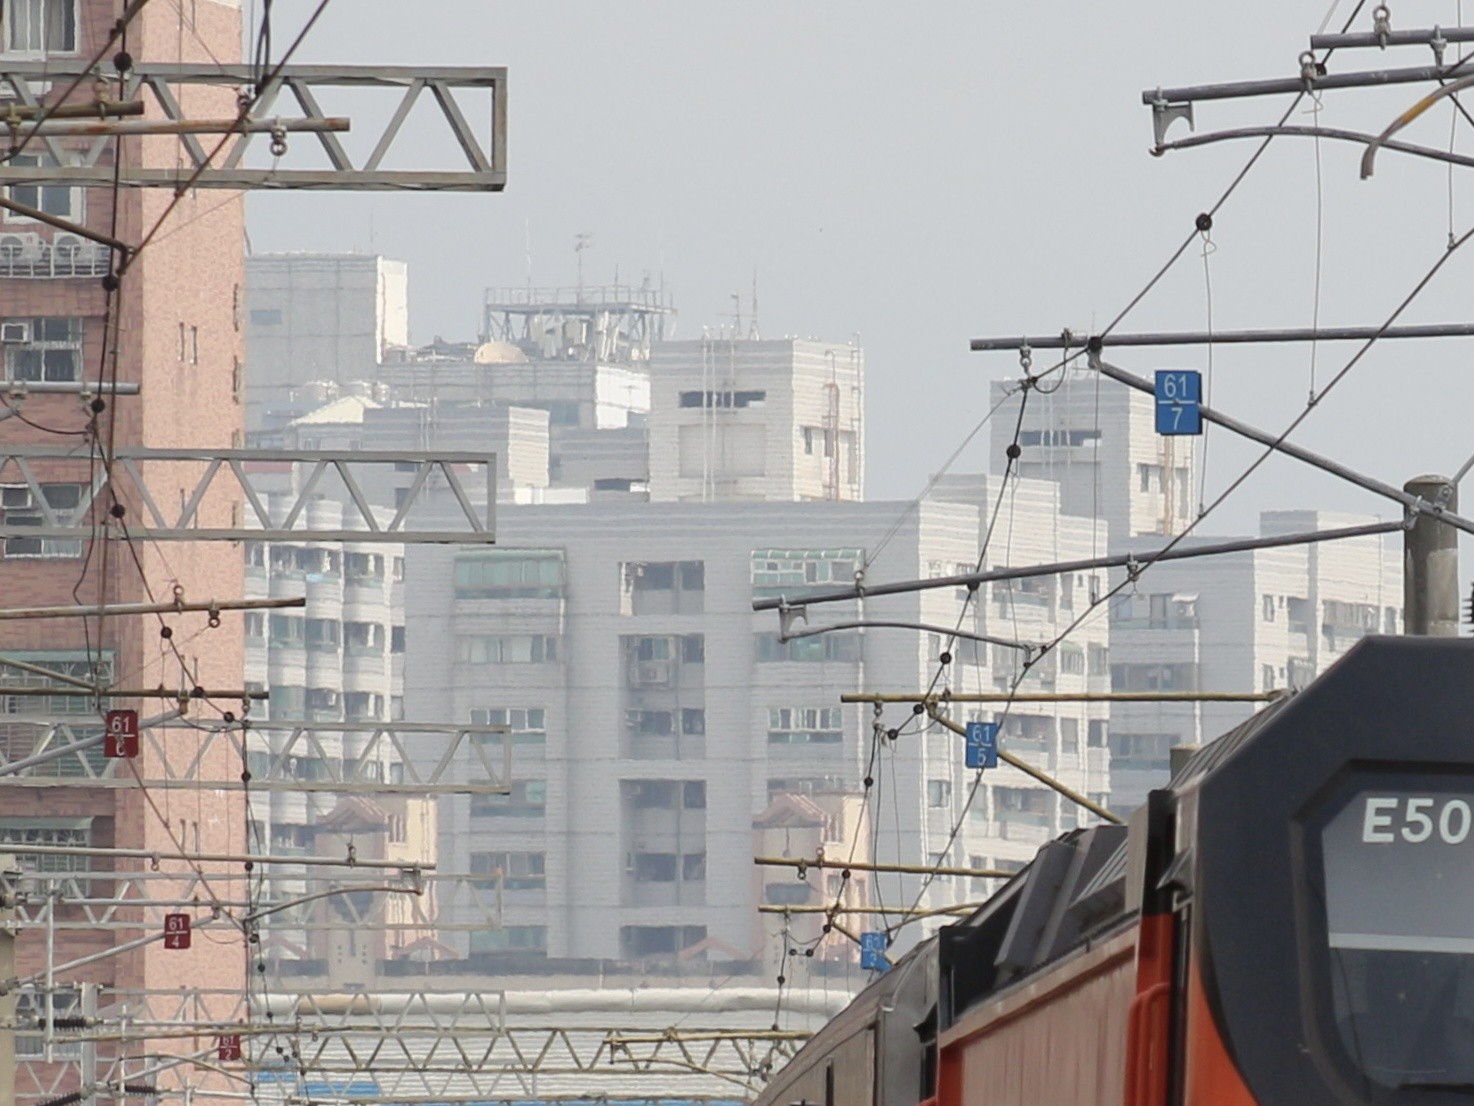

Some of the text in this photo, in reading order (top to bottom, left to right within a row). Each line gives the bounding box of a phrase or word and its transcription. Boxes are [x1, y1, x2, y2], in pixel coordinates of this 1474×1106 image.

[1163, 373, 1188, 398] 61
[1170, 407, 1183, 431] 7
[112, 716, 130, 733] 61
[972, 724, 990, 742] 61
[977, 747, 987, 766] 5
[168, 916, 184, 931] 61
[171, 935, 180, 948] 4
[224, 1049, 233, 1060] 2
